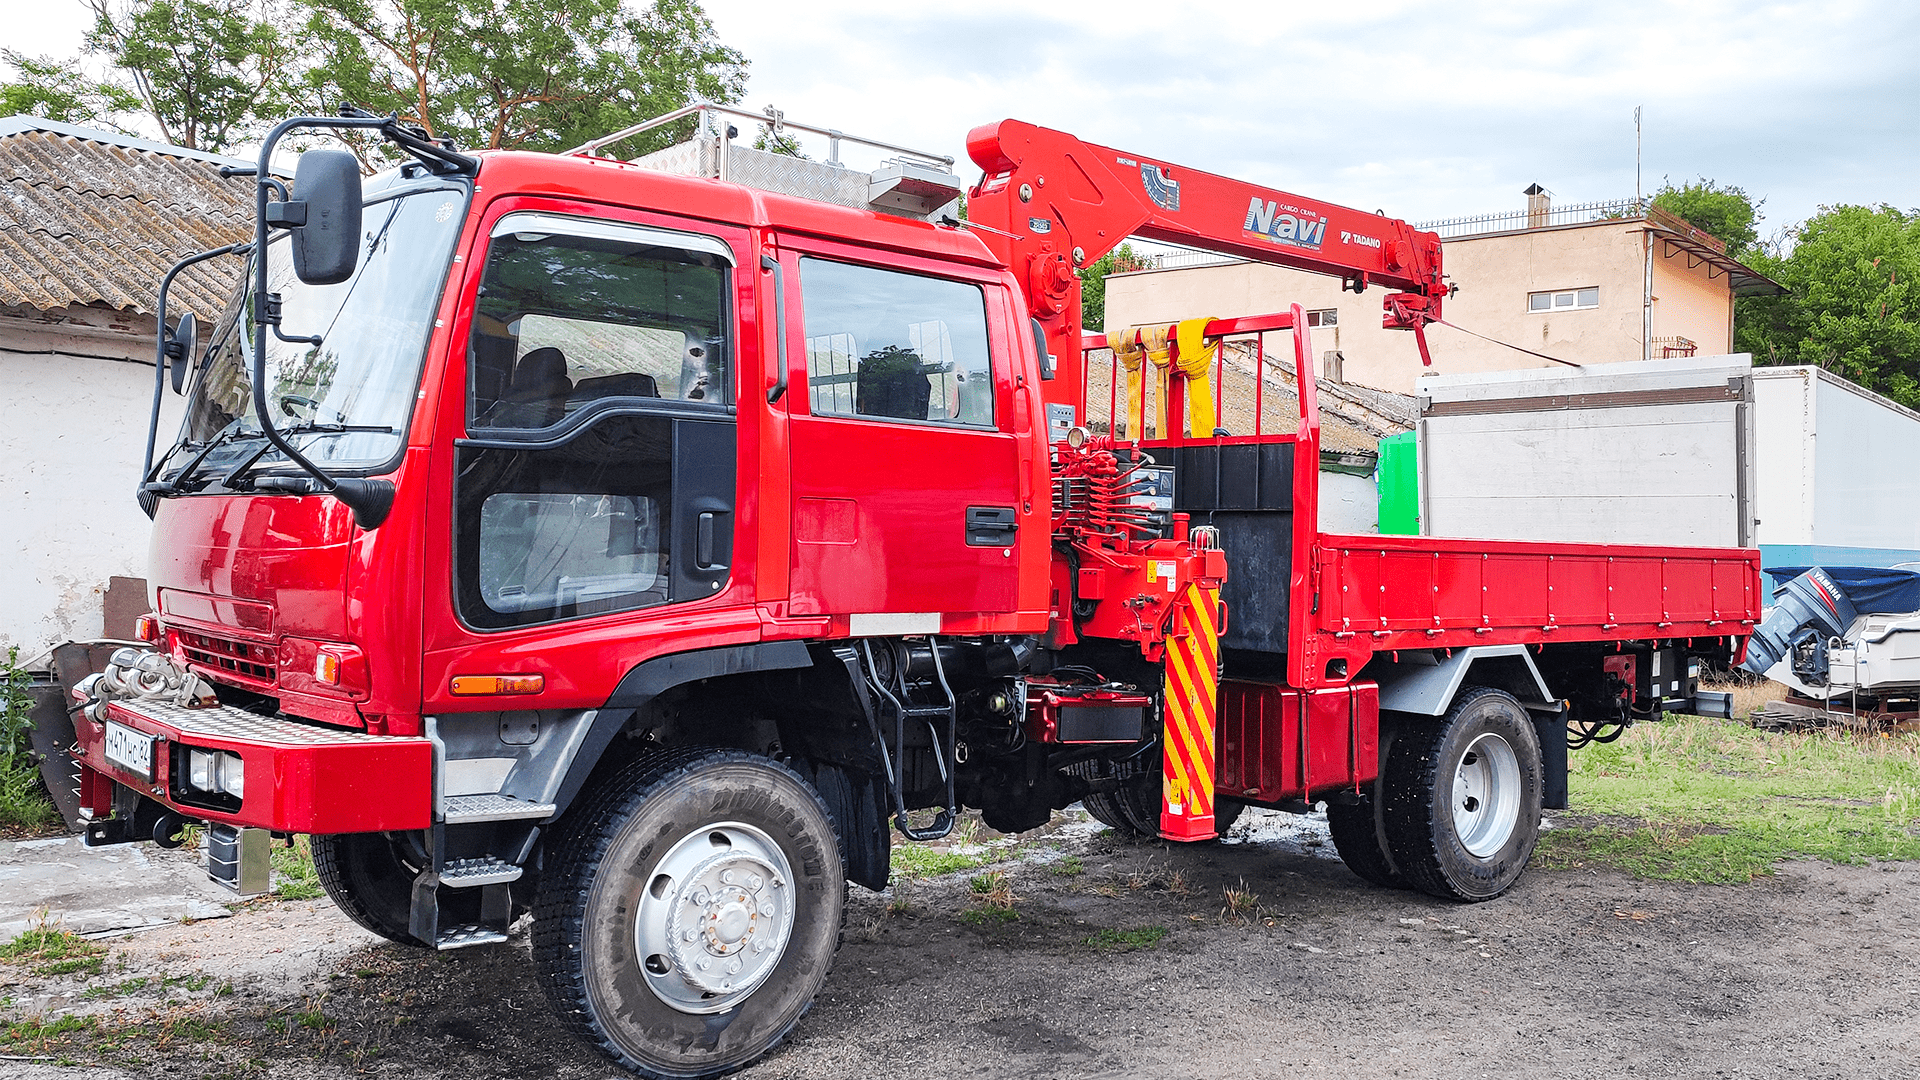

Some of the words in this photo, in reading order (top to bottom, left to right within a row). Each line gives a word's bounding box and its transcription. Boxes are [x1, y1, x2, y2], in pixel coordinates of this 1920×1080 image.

[1243, 196, 1327, 245] Navi
[1280, 203, 1298, 213] CARGO
[1300, 208, 1316, 217] CRANE
[1352, 234, 1381, 248] TADANO
[1814, 571, 1842, 601] YAMAHA
